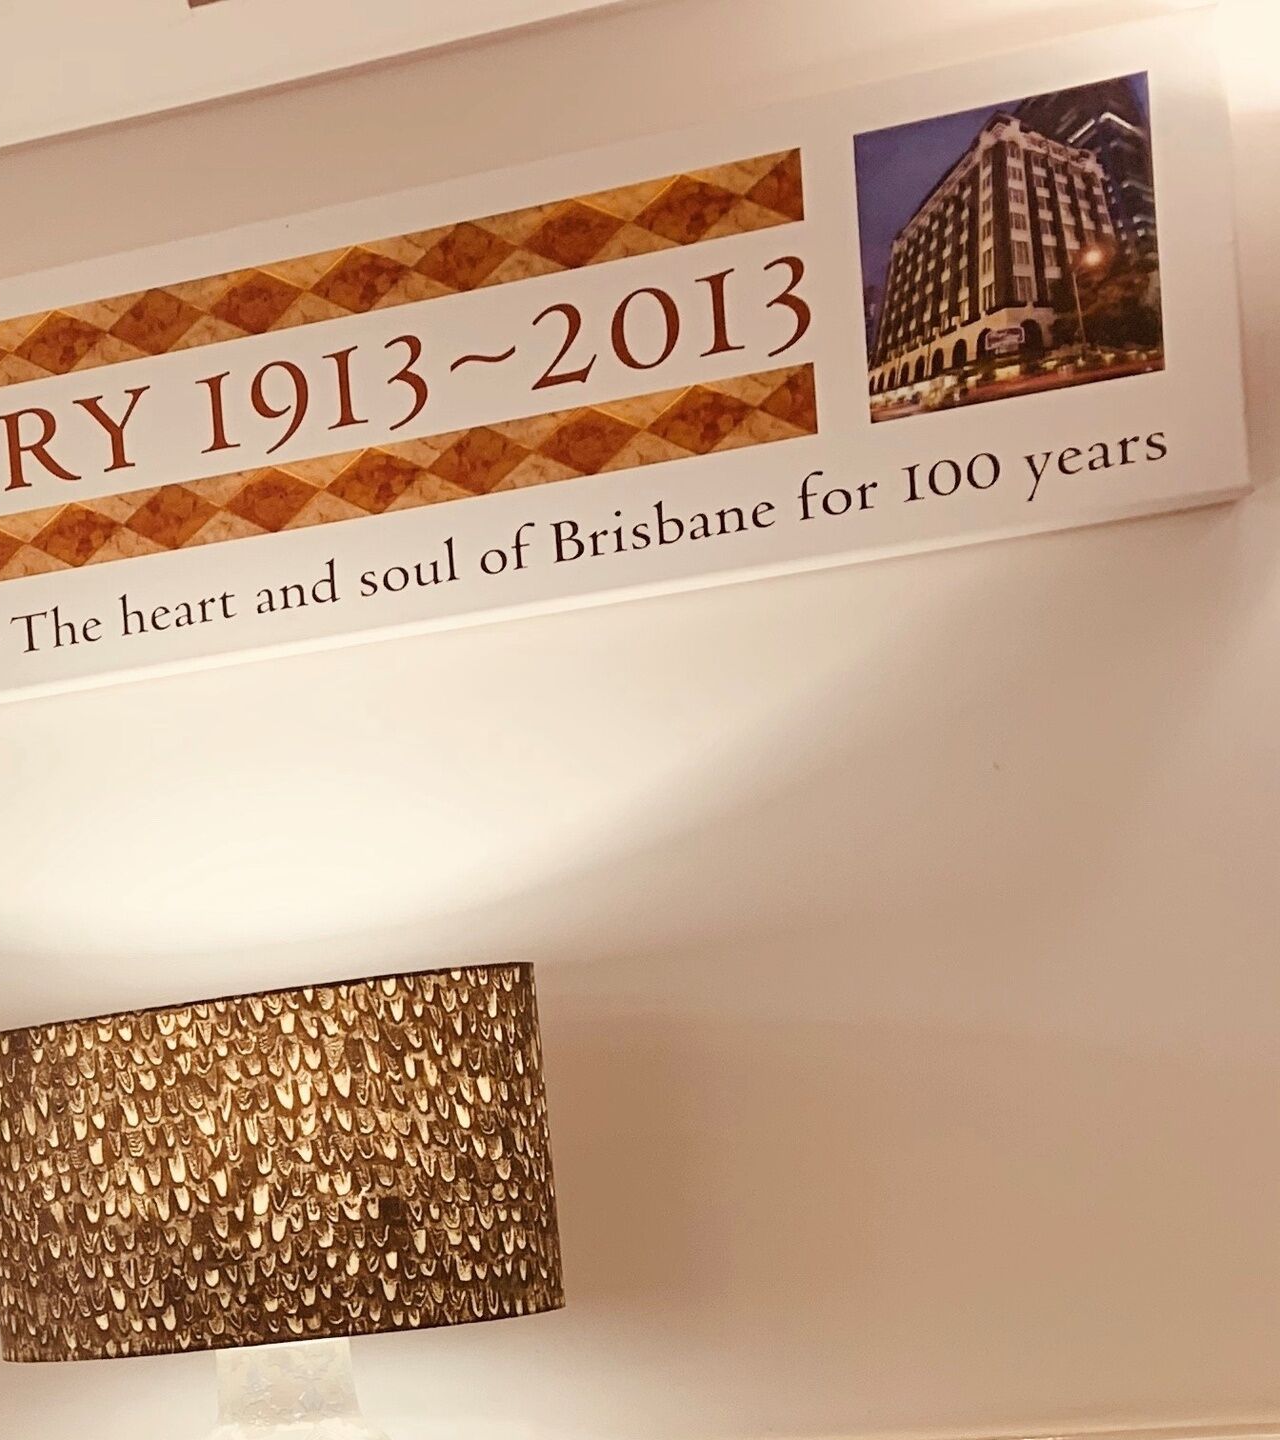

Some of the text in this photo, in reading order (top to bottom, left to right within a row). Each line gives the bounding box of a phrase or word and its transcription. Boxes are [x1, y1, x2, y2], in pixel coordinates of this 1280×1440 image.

[9, 603, 105, 654] The
[118, 585, 236, 637] heart
[255, 555, 342, 612] and
[359, 534, 461, 598] soul
[479, 521, 537, 576] of
[547, 488, 777, 566] Brisbane
[796, 469, 879, 522] for
[900, 448, 1002, 503] 100
[1022, 425, 1169, 504] years
